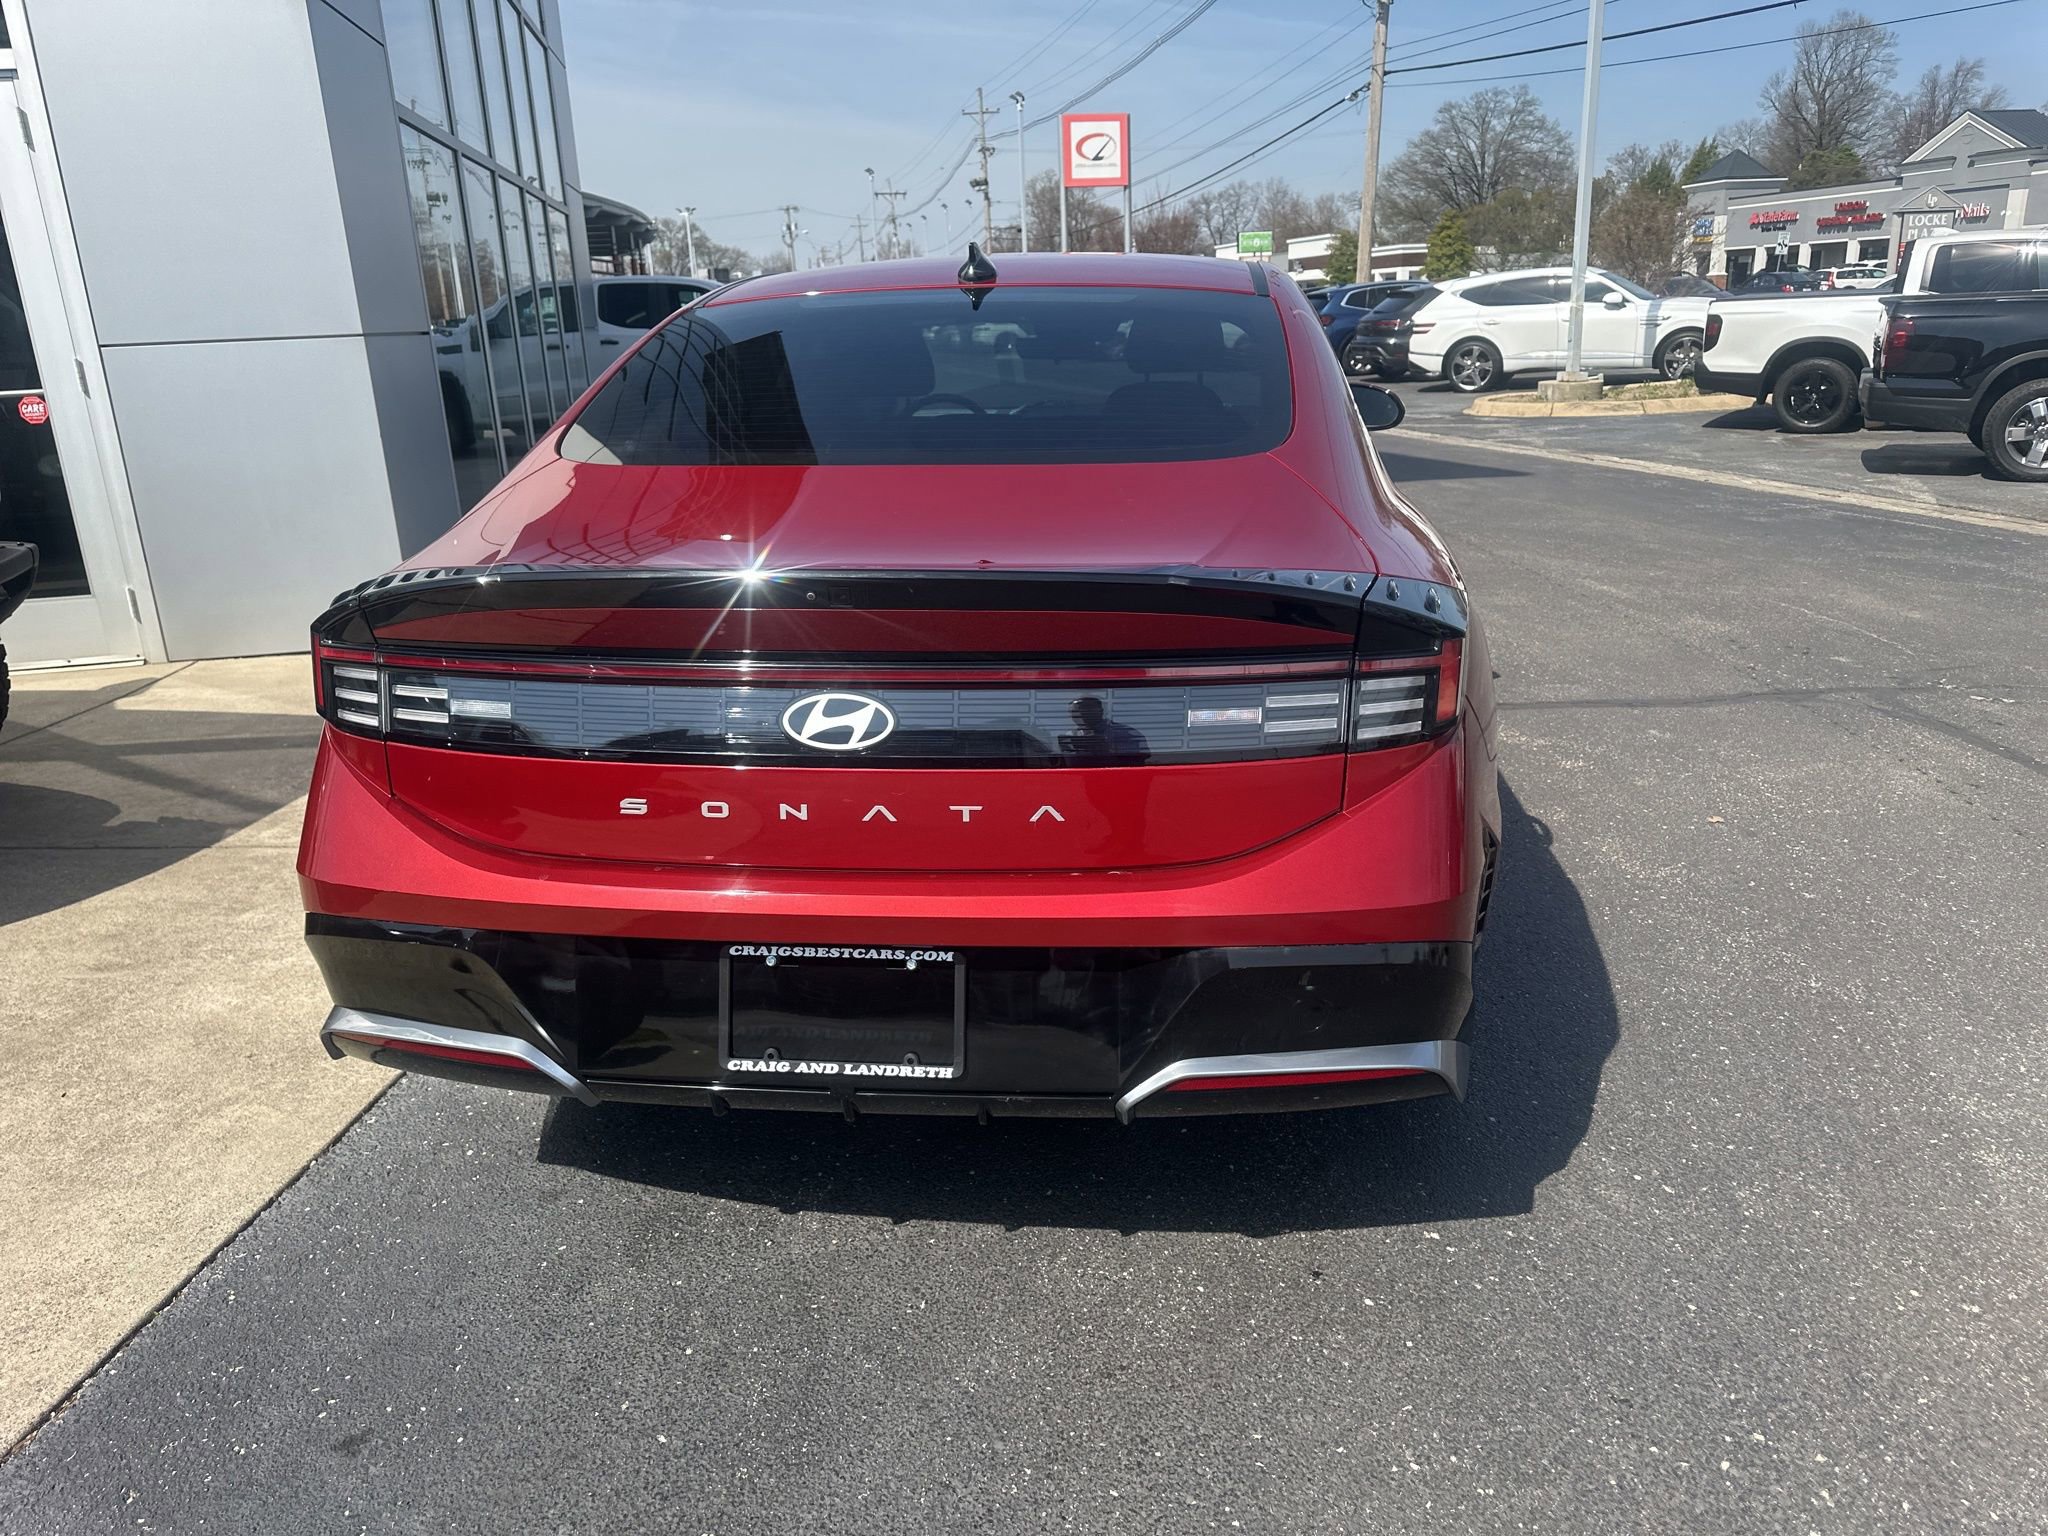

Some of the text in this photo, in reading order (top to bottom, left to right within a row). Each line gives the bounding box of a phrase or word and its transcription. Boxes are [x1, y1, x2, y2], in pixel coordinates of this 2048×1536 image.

[1908, 213, 1948, 226] LOCKE
[21, 403, 45, 412] CARE
[619, 798, 1066, 822] SONATA
[729, 945, 954, 962] CRAIGSBESTCARS.COM
[727, 1060, 954, 1078] CRAIG AND LANDRETH
